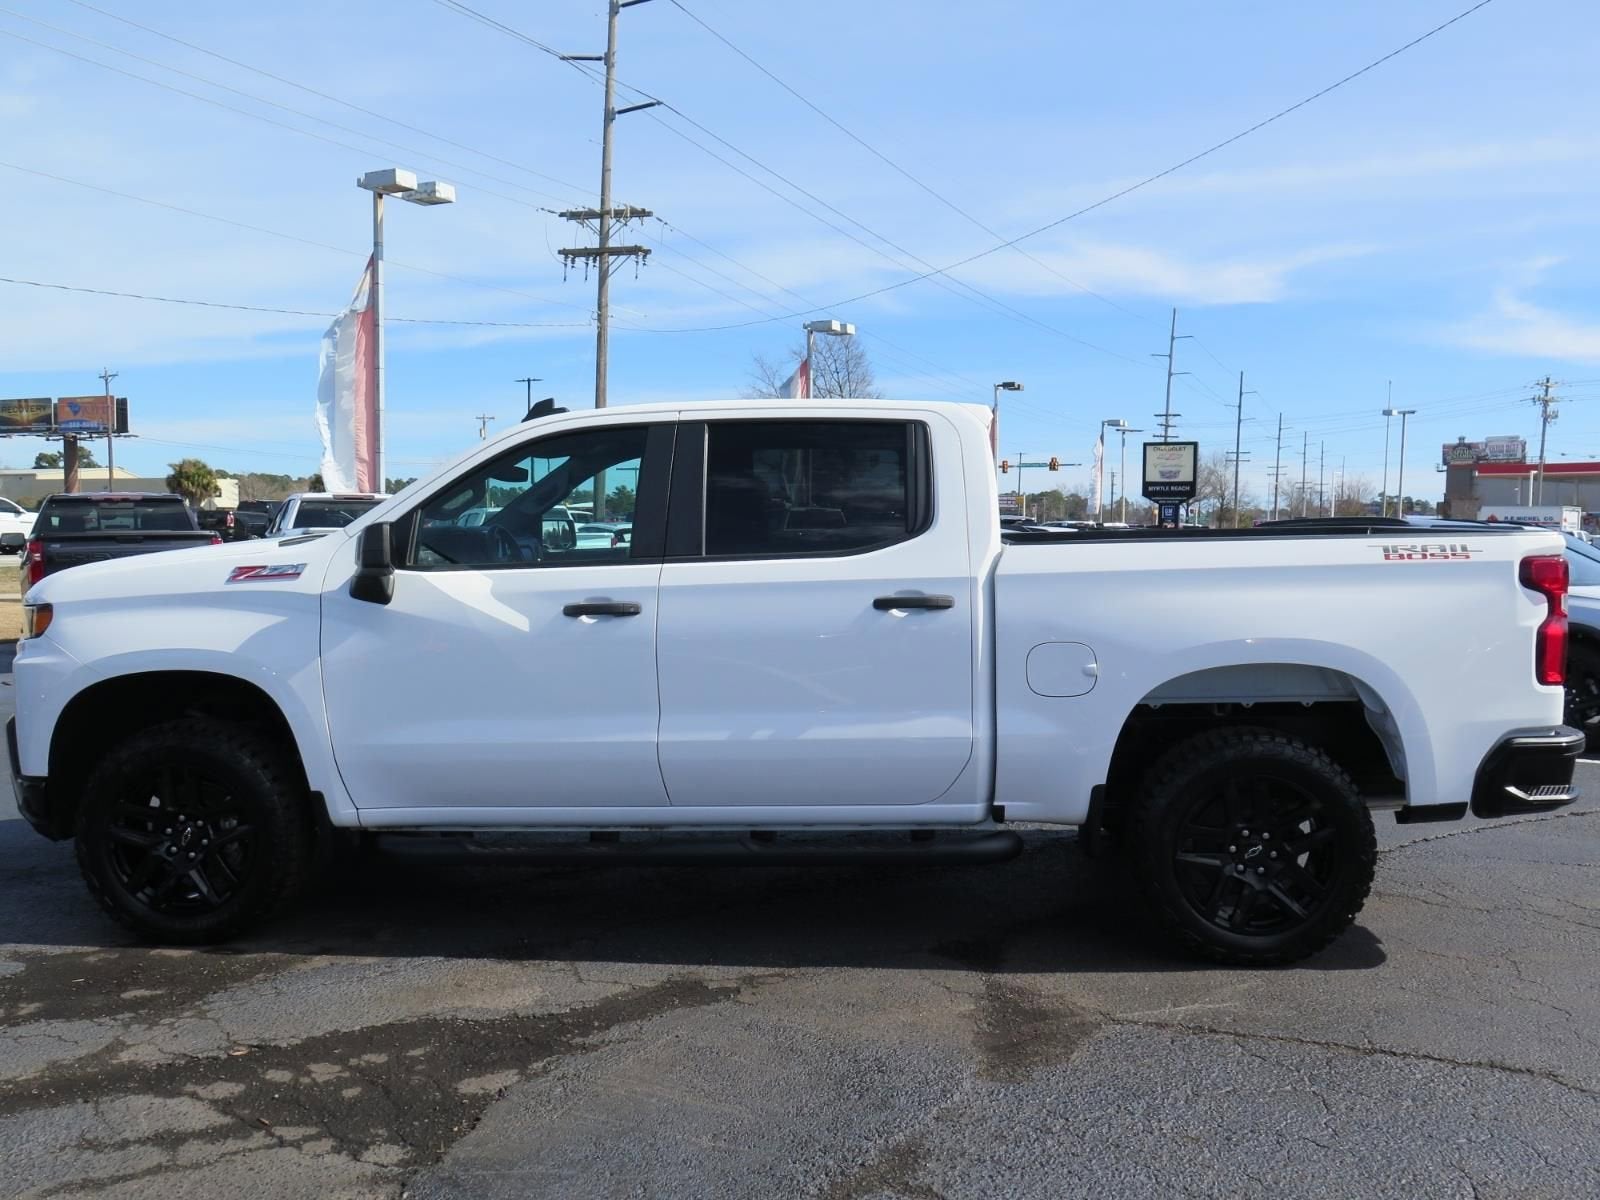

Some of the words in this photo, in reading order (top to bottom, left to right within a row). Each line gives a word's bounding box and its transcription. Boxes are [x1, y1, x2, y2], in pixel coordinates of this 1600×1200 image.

[1367, 544, 1483, 553] TRAIL
[1383, 552, 1471, 561] BOSS
[225, 563, 308, 585] Z71
